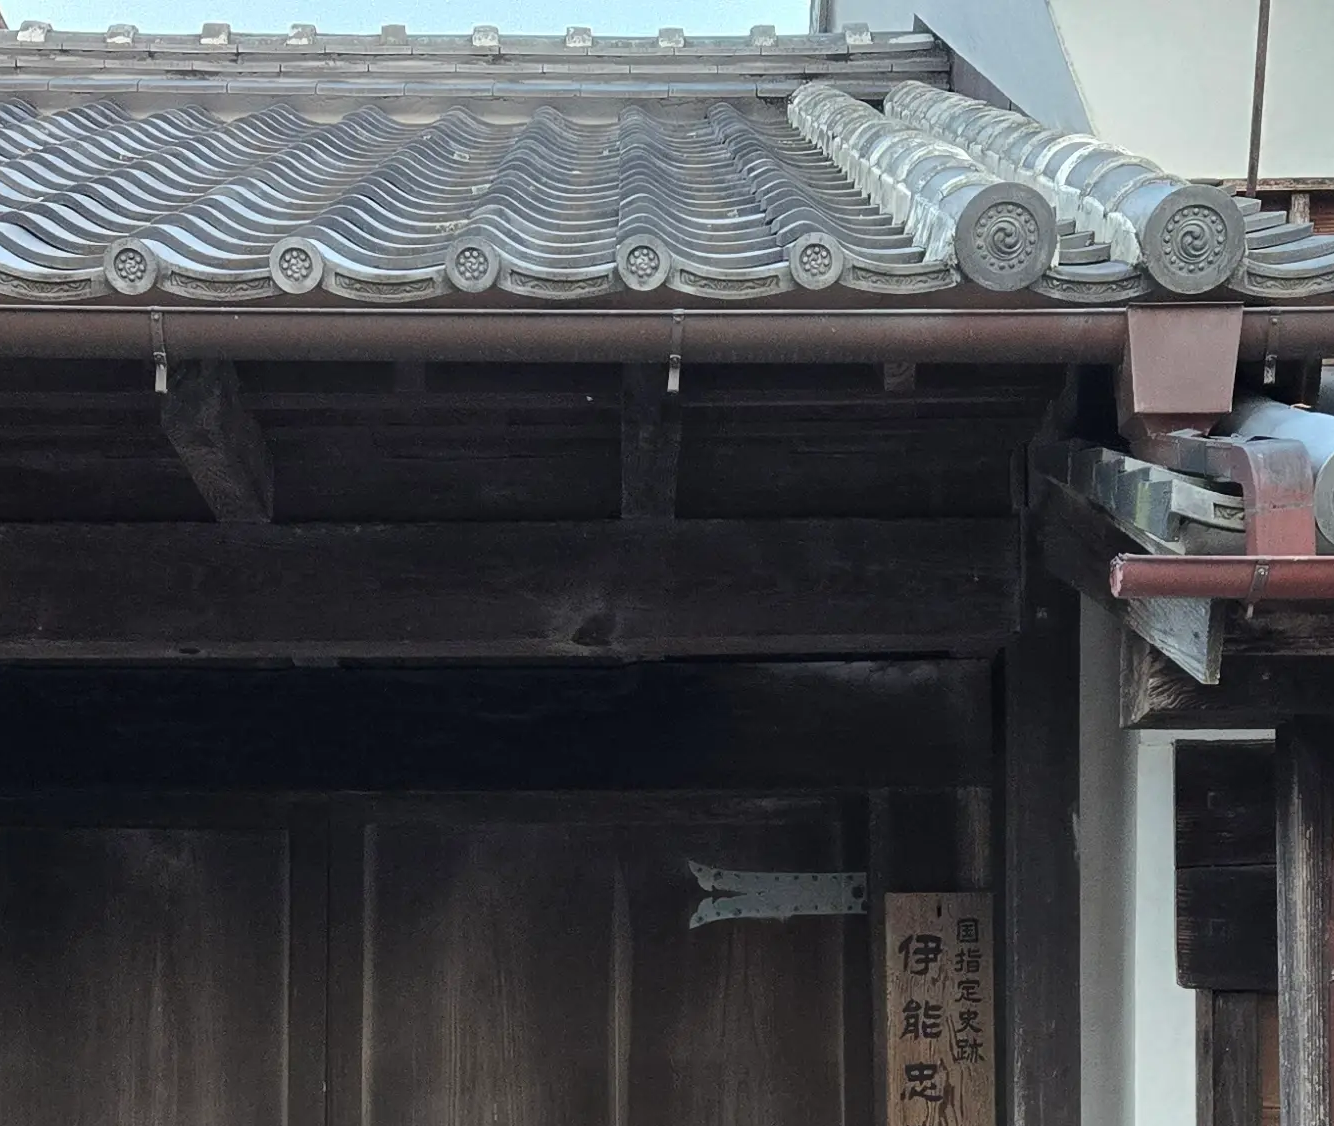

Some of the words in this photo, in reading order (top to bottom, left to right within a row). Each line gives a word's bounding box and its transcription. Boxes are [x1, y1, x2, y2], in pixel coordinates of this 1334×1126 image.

[955, 918, 985, 1064] 国指定史跡
